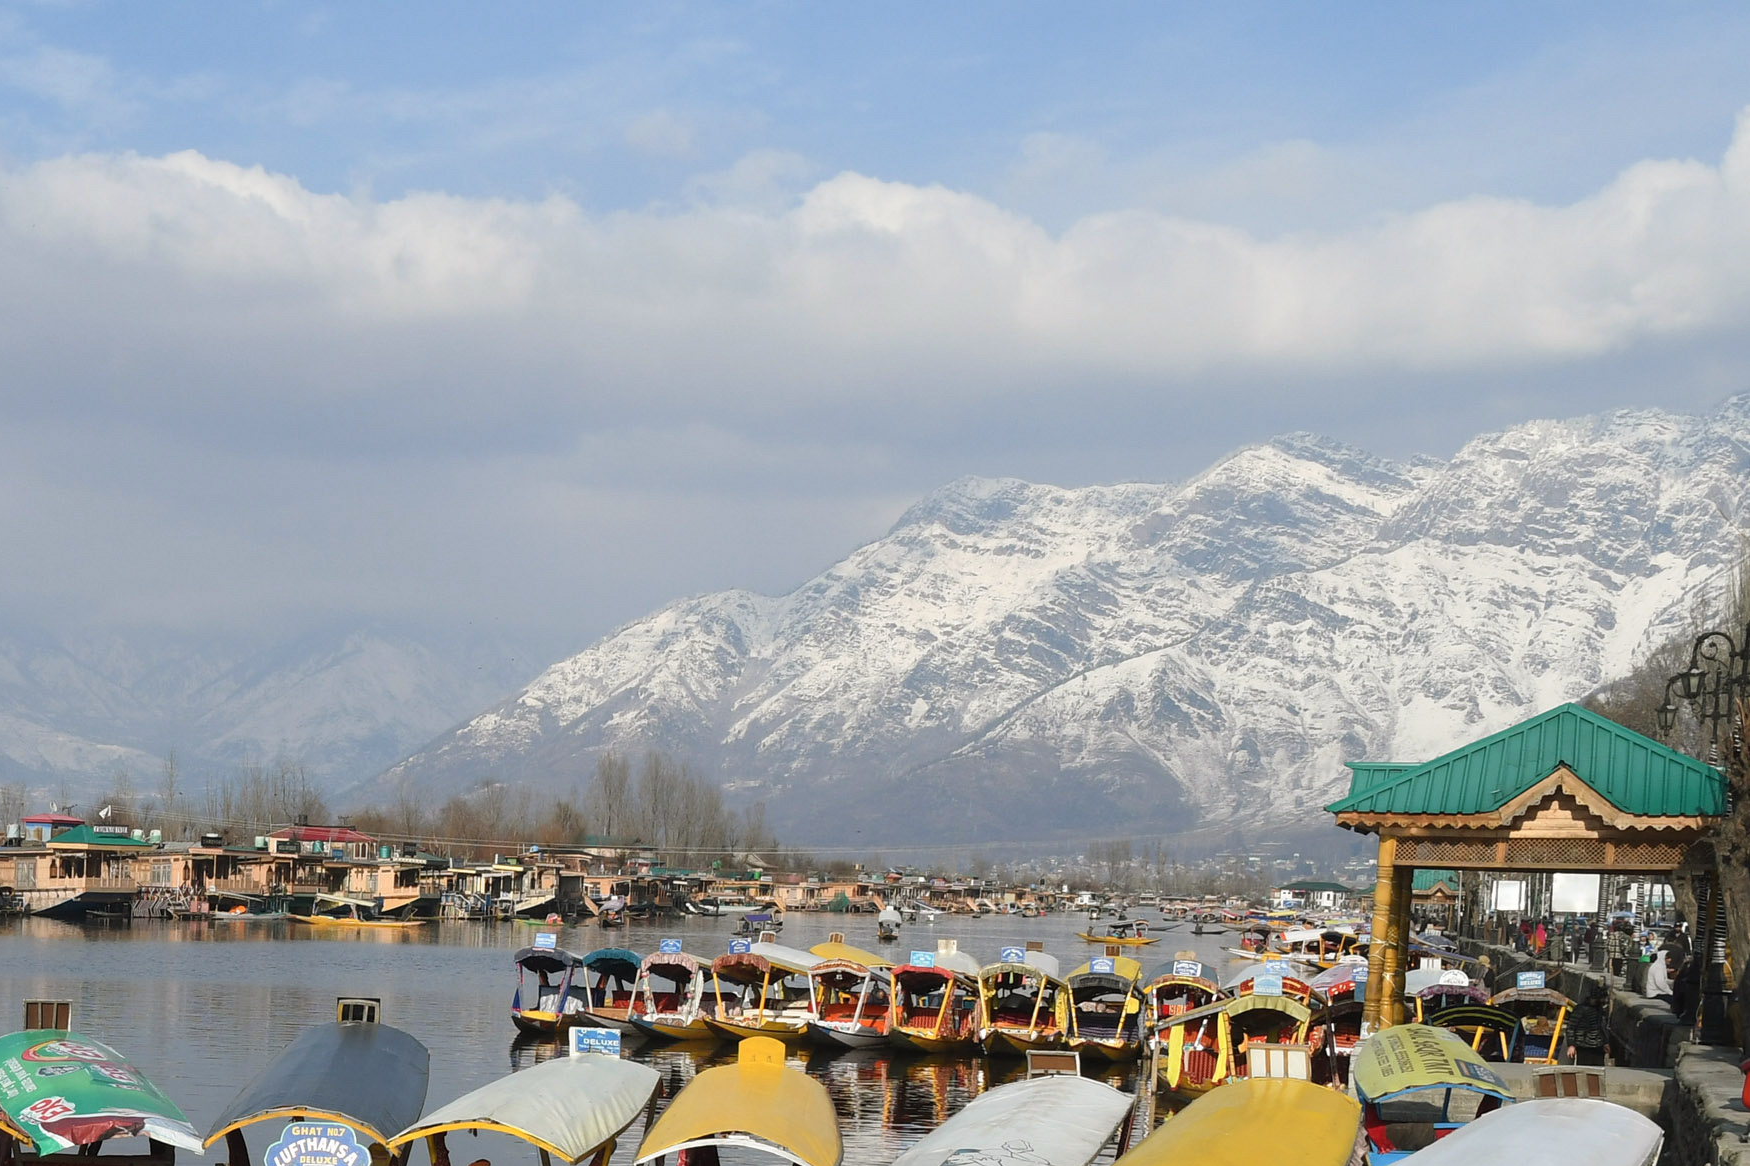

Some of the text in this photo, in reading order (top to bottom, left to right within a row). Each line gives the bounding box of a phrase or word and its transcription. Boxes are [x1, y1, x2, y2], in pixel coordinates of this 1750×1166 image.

[583, 1038, 619, 1046] DELUXE
[291, 1126, 323, 1136] GHAT
[299, 1155, 338, 1165] DELUXE
